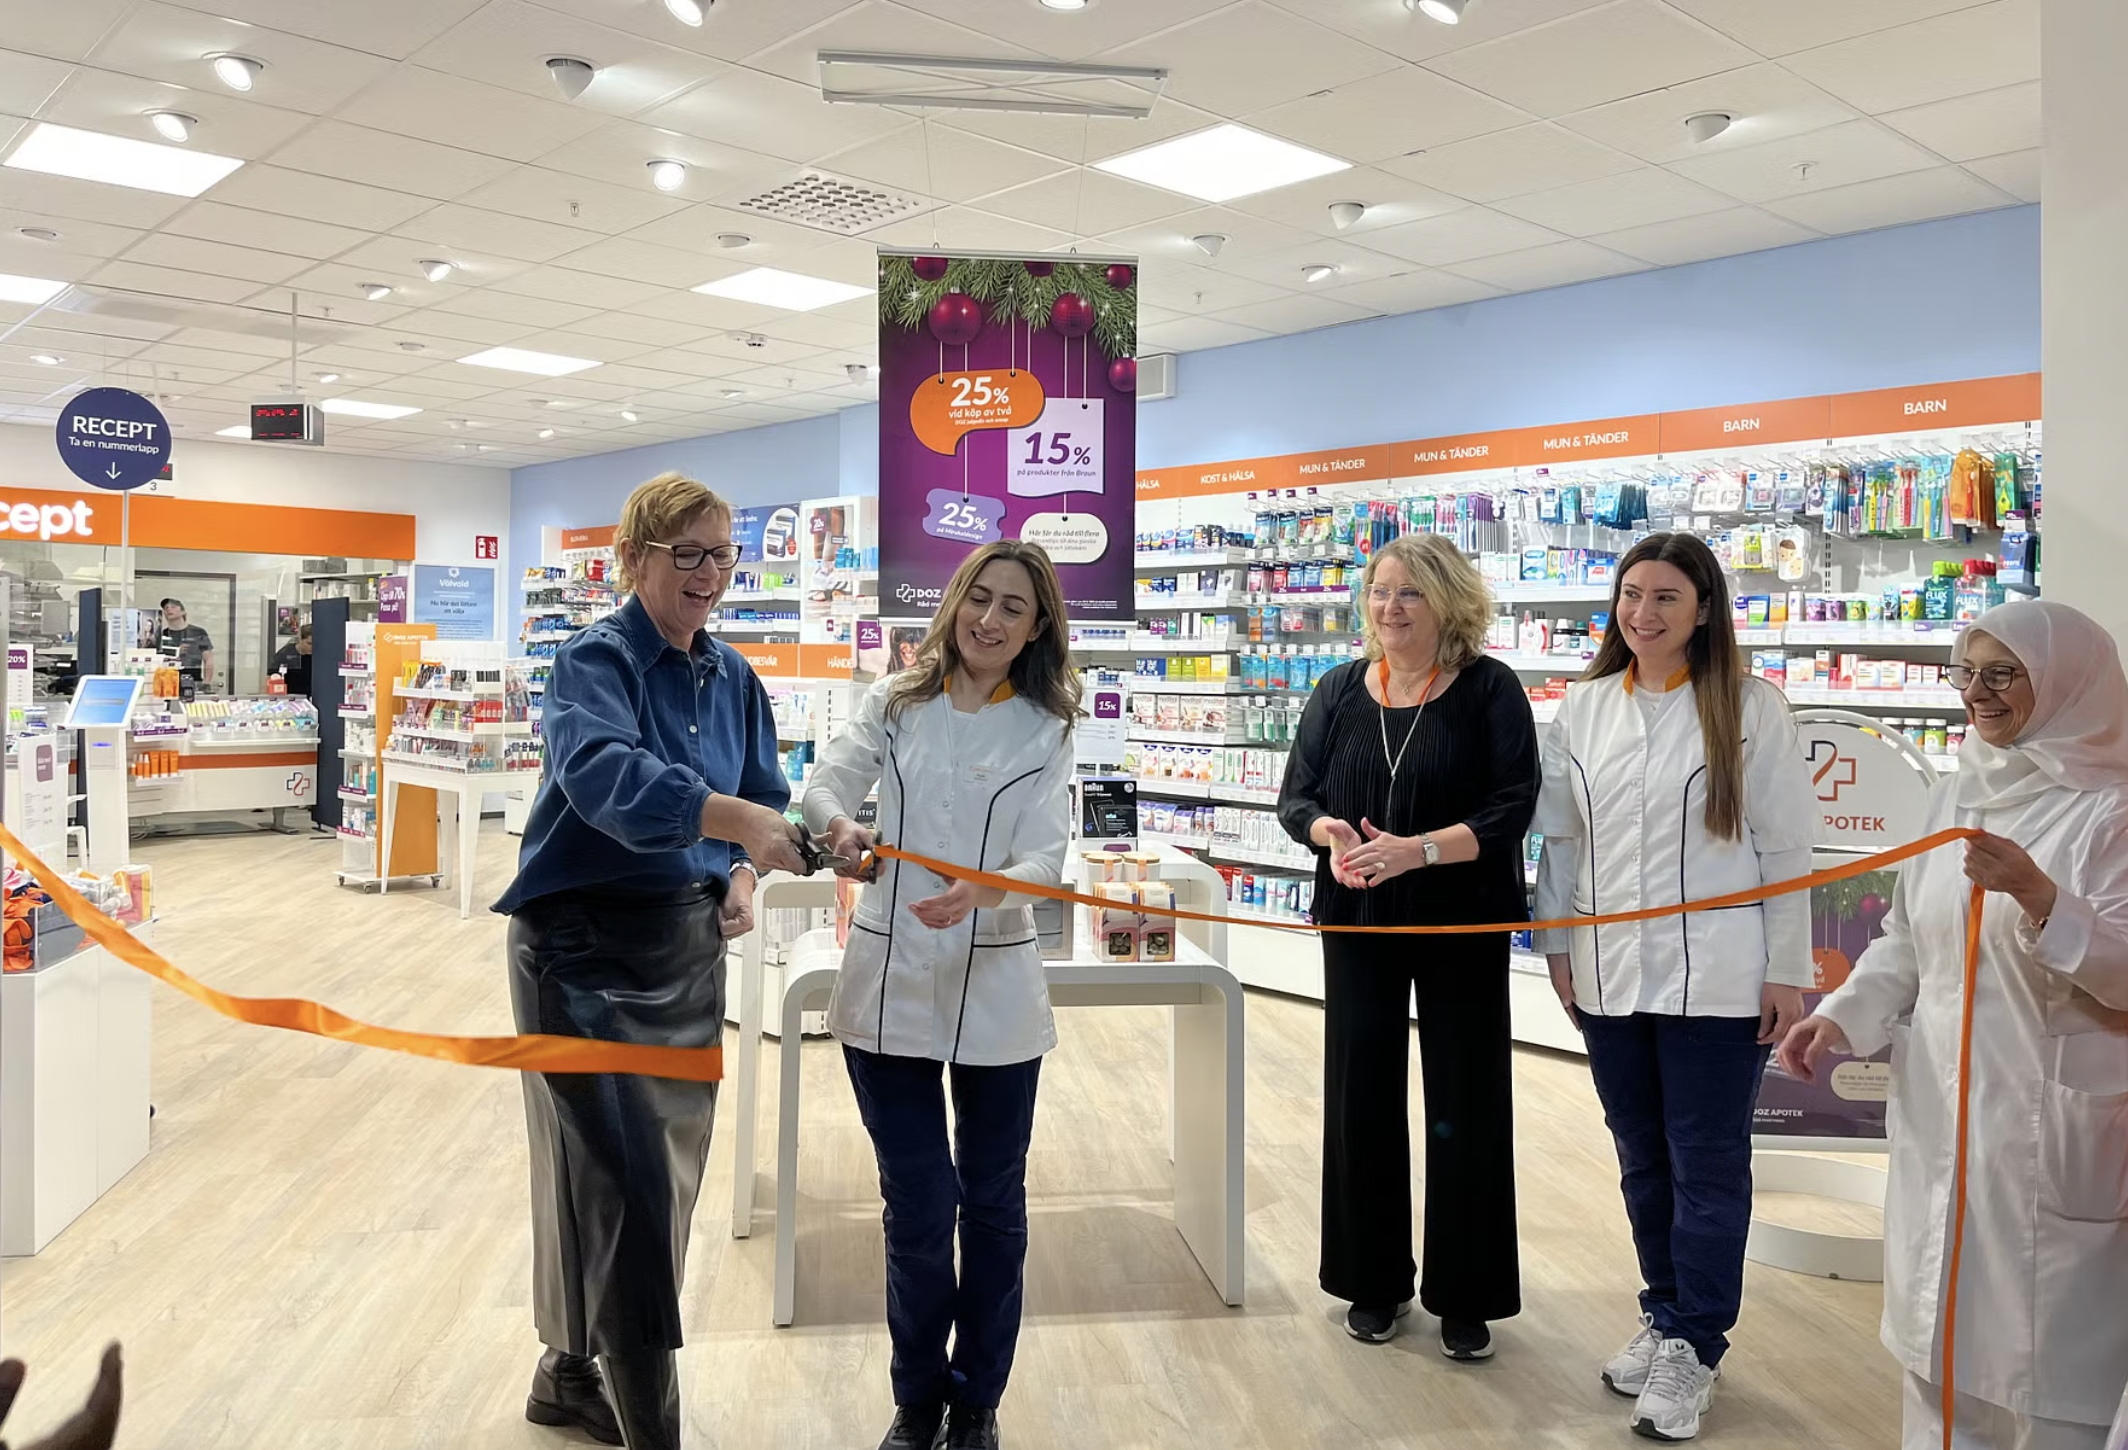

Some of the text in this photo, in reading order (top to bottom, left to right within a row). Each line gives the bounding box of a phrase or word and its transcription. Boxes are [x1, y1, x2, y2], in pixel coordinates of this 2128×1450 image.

[950, 376, 1009, 407] 25%
[948, 404, 1012, 419] vid köp av två
[1903, 398, 1947, 415] BARN
[73, 415, 157, 440] RECEPT
[1723, 417, 1760, 433] BARN
[68, 436, 160, 455] Ta en nummerlapp
[1543, 431, 1629, 450] MUN & TÄNDER
[1025, 432, 1091, 465] 15%
[1414, 445, 1489, 463] MUN & TÄNDER
[1017, 469, 1026, 477] på
[1061, 469, 1075, 477] från
[1299, 459, 1366, 475] MUN & TÄNDER
[1136, 478, 1160, 490] HÄLSA
[1201, 473, 1221, 485] KOST
[1229, 470, 1256, 482] HÄLSA
[150, 482, 157, 491] 3
[939, 502, 988, 532] 25%
[439, 579, 470, 588] Välvald
[917, 588, 941, 598] DOZ
[1926, 591, 1947, 599] FLUX
[1956, 596, 1979, 606] FLUX
[1098, 700, 1117, 712] 15%
[1823, 815, 1885, 831] POTEK
[1771, 1108, 1804, 1117] APOTEK
